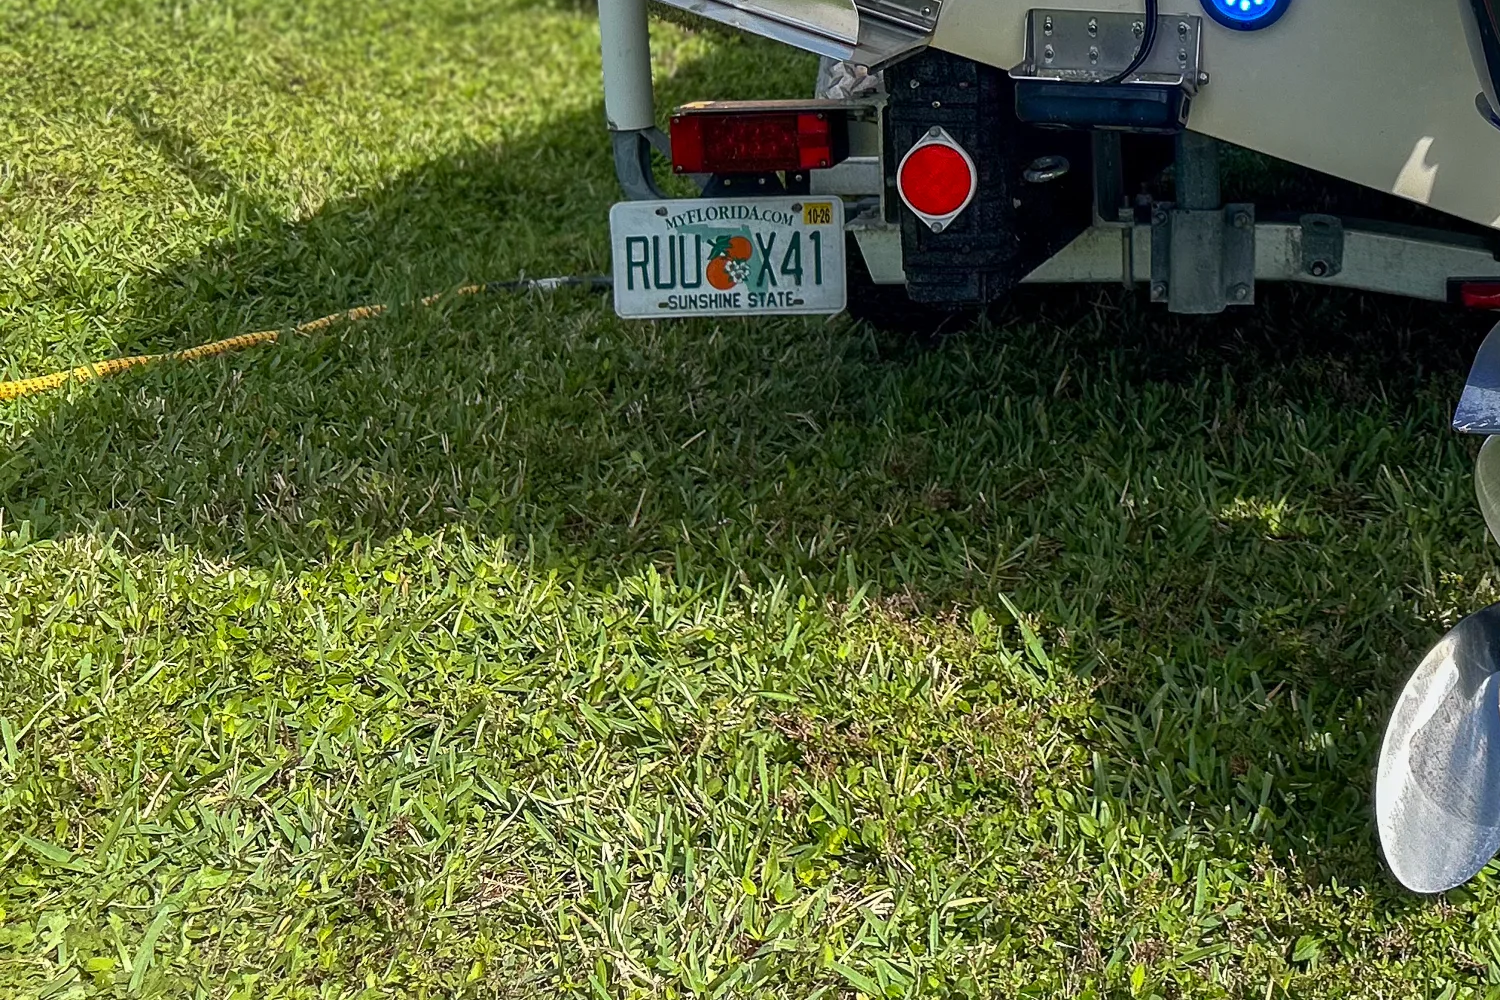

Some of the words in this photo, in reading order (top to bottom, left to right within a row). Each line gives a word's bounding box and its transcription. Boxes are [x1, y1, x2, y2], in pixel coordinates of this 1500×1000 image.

[666, 205, 794, 230] MYFLORIDA.COM
[807, 207, 831, 224] 10-26
[626, 234, 701, 290] RUU
[756, 230, 823, 288] X41
[667, 292, 741, 310] SUNSHINE
[748, 291, 794, 308] STATE
